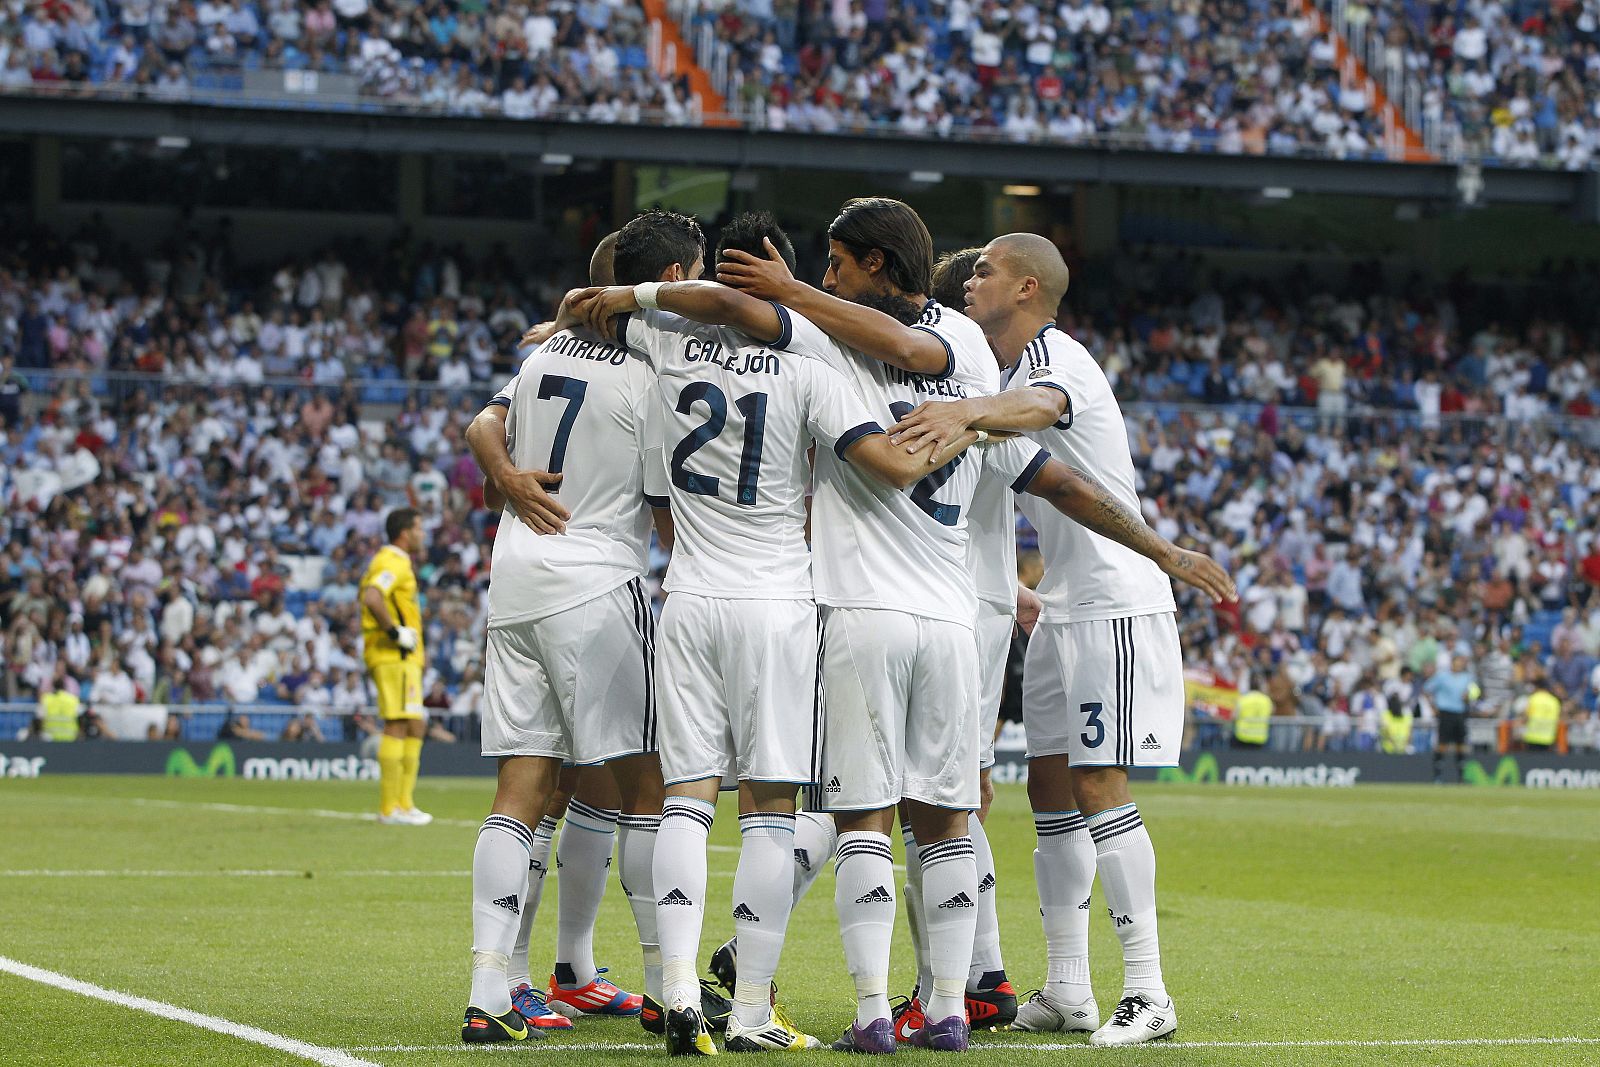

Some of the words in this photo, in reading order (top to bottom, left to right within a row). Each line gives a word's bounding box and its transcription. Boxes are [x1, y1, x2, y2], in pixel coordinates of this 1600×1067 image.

[541, 334, 629, 366] RONALDO
[685, 338, 780, 376] CALEJÓN
[537, 373, 589, 494] 7
[671, 381, 768, 505] 21
[1080, 702, 1105, 749] 3
[243, 754, 382, 781] movista
[1225, 763, 1361, 788] movistar
